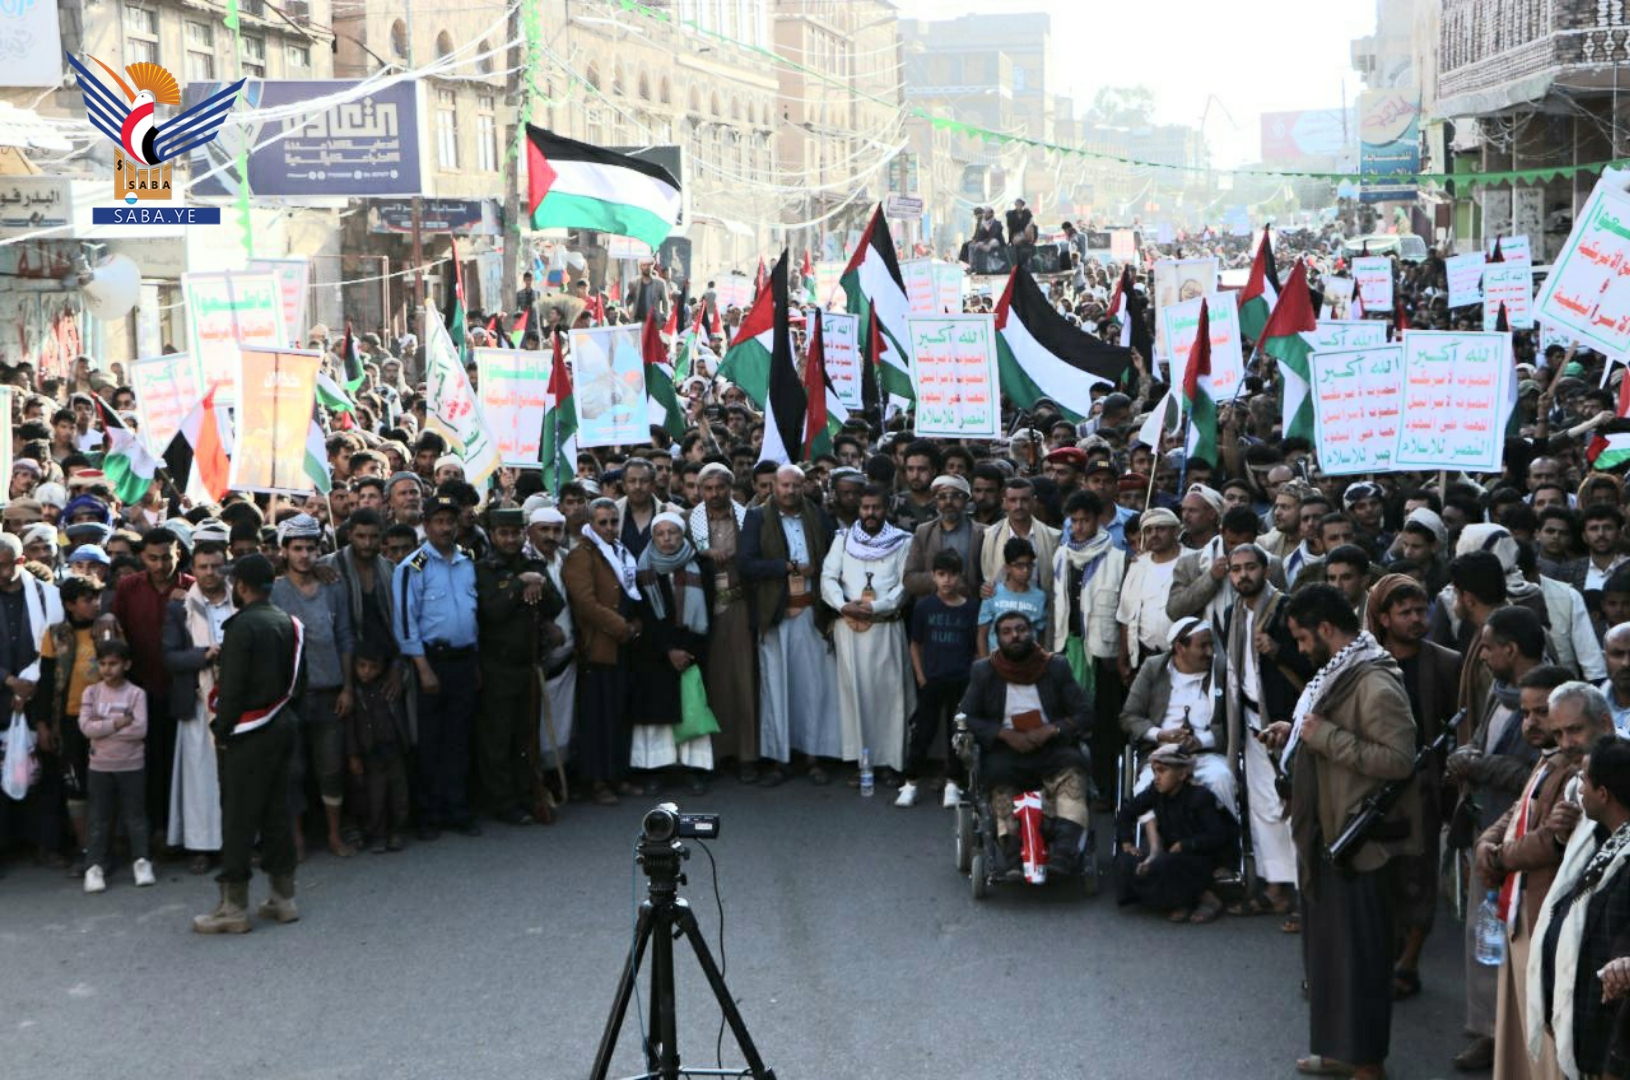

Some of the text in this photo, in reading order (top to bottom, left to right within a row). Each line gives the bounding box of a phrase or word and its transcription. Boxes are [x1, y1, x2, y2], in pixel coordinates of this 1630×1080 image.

[958, 326, 984, 344] الله
[1466, 343, 1499, 363] الله
[1370, 355, 1400, 374] الله
